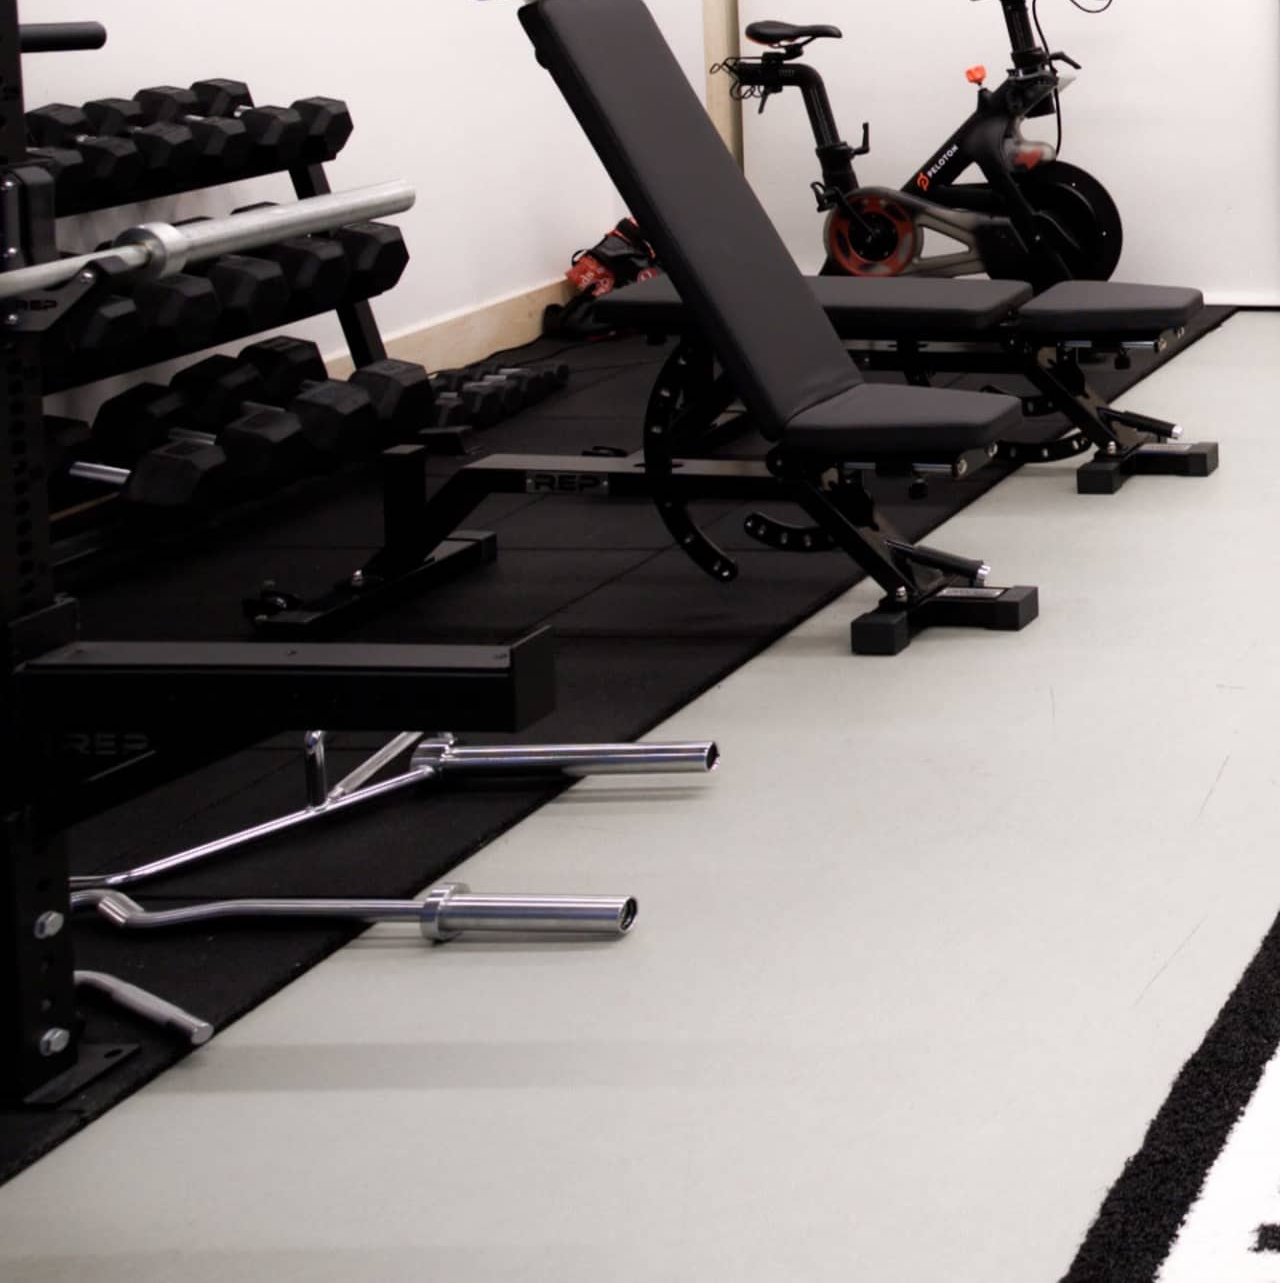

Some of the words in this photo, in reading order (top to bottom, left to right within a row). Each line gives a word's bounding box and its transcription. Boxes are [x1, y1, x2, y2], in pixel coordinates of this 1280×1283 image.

[926, 143, 959, 178] PELOTON
[534, 473, 601, 494] REP
[62, 733, 150, 756] REP
